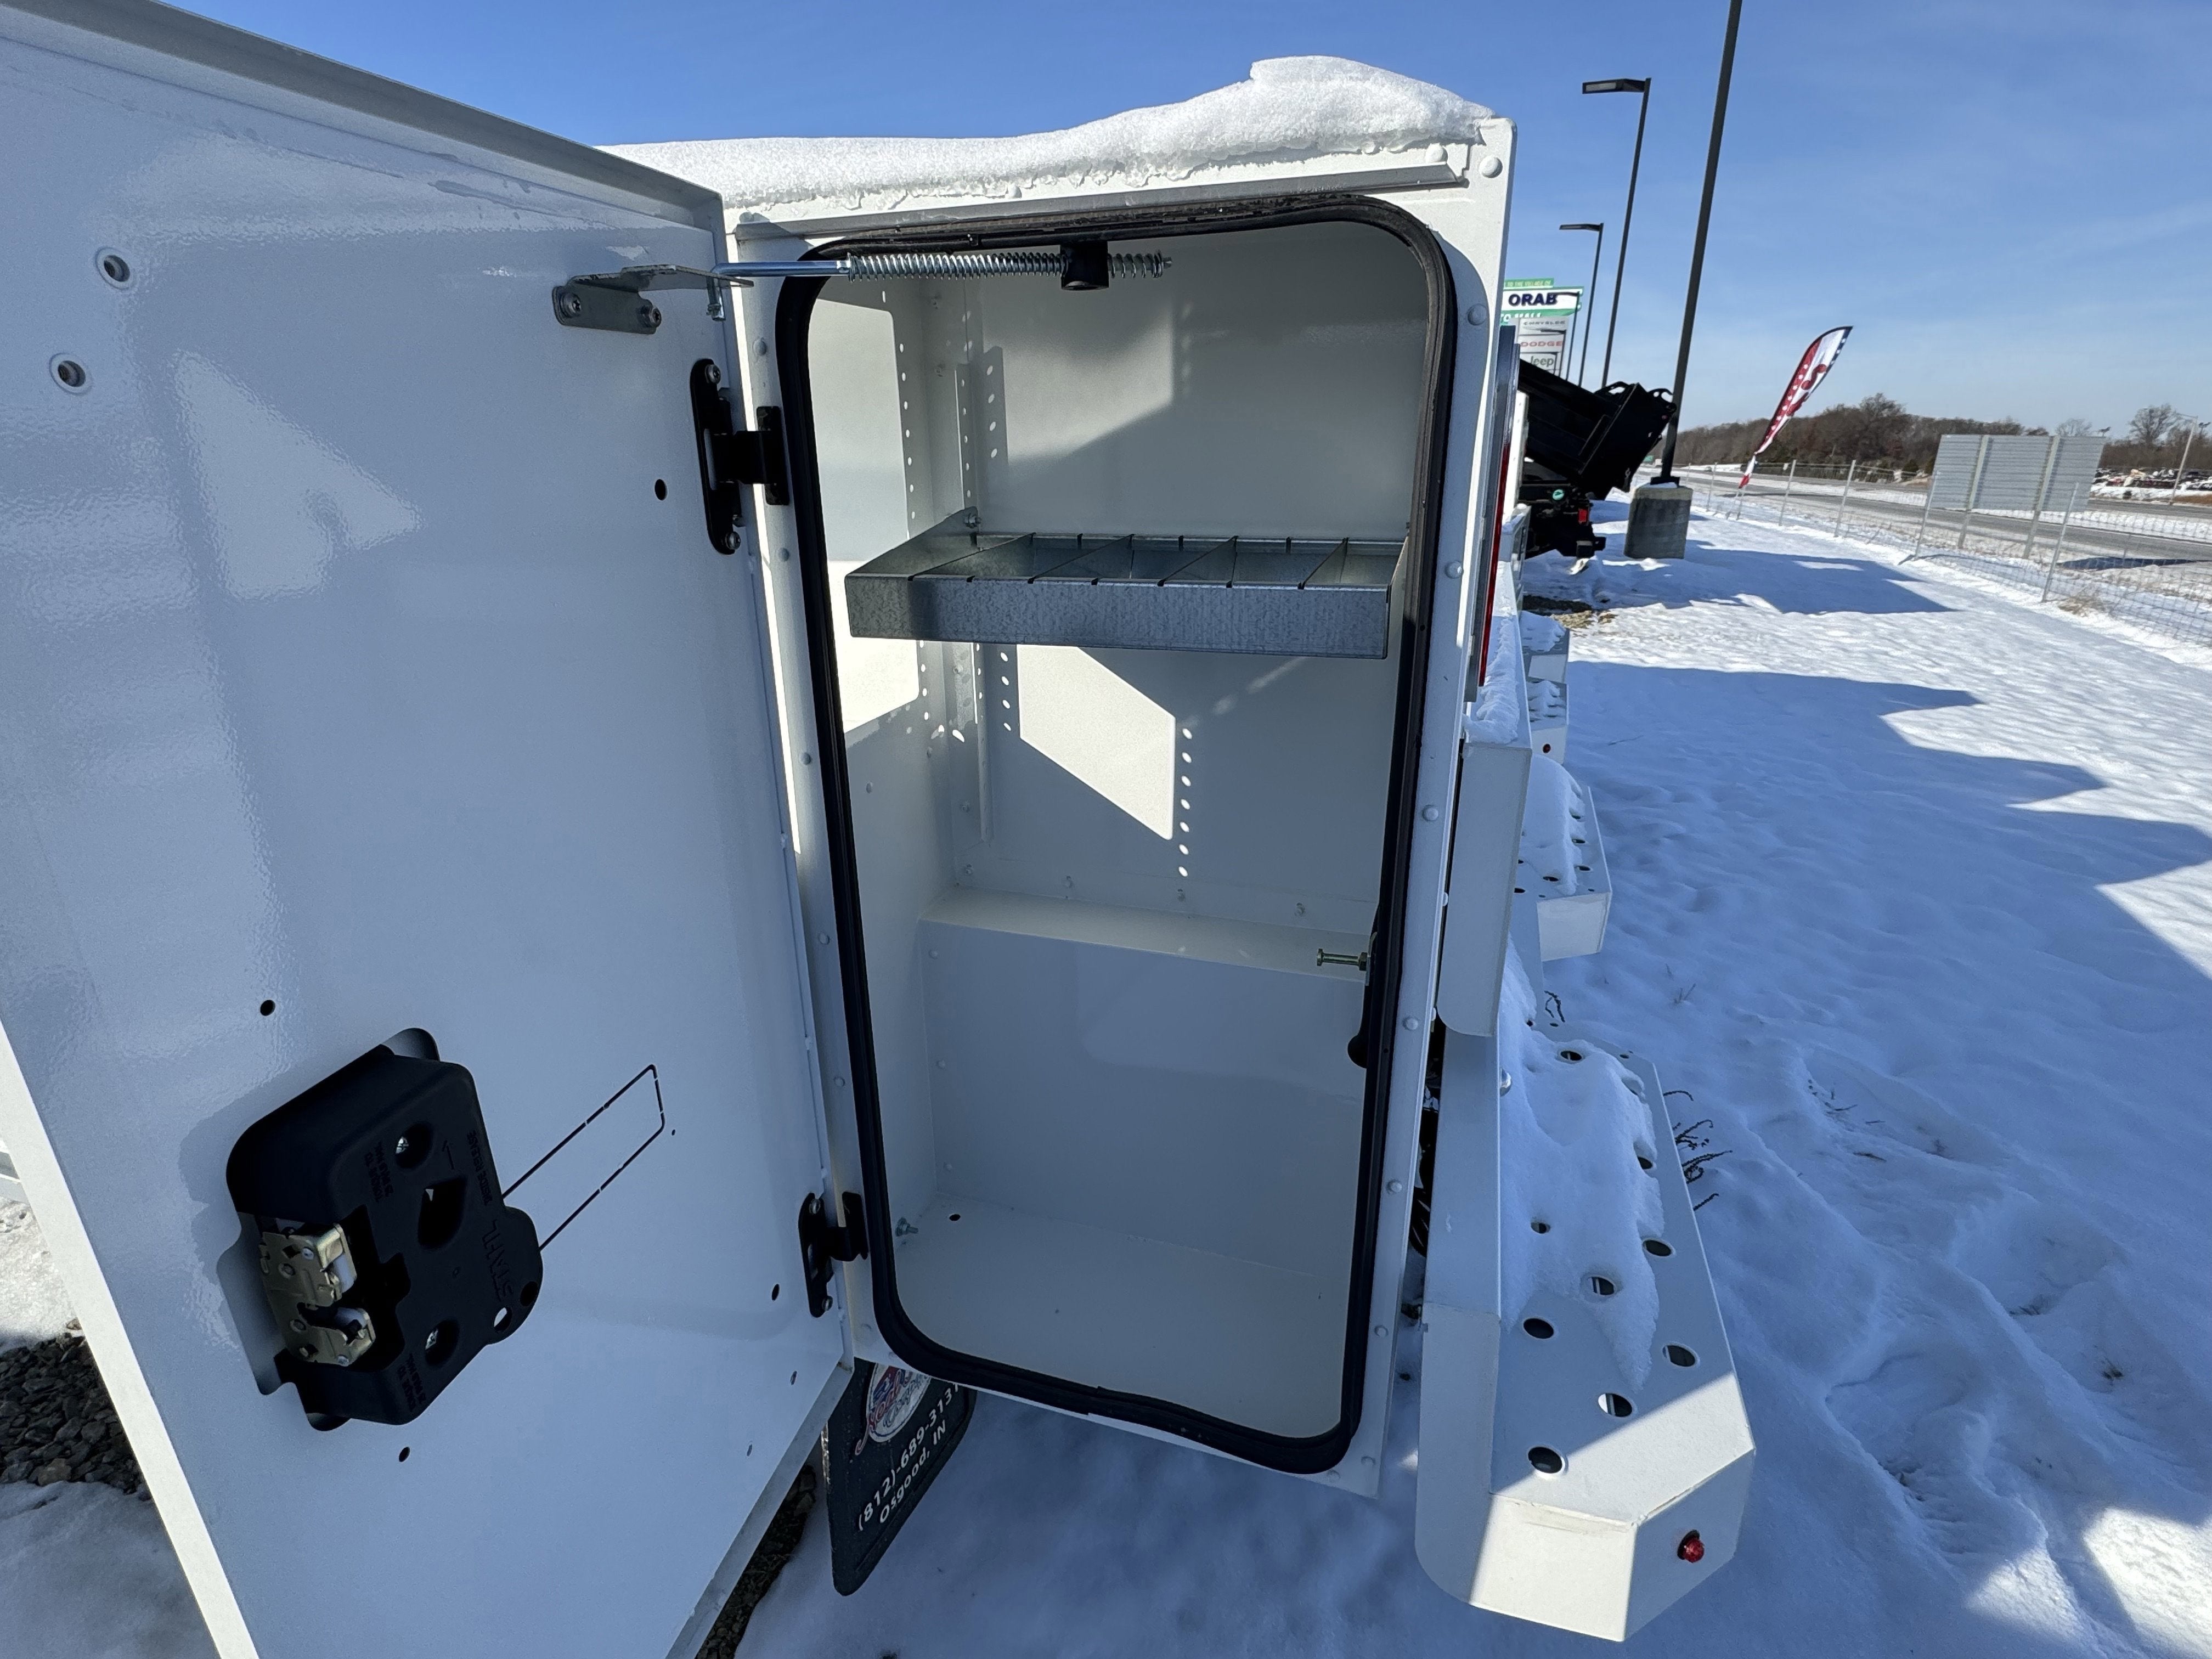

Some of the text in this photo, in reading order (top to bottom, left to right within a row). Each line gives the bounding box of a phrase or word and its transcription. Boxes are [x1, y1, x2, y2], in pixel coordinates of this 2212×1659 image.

[1508, 293, 1558, 306] ORAB
[1530, 356, 1554, 367] Jeep
[466, 1130, 485, 1172] RELEASE
[482, 1218, 514, 1302] STAHL
[880, 1447, 930, 1523] Osgood,
[933, 1420, 946, 1445] IN
